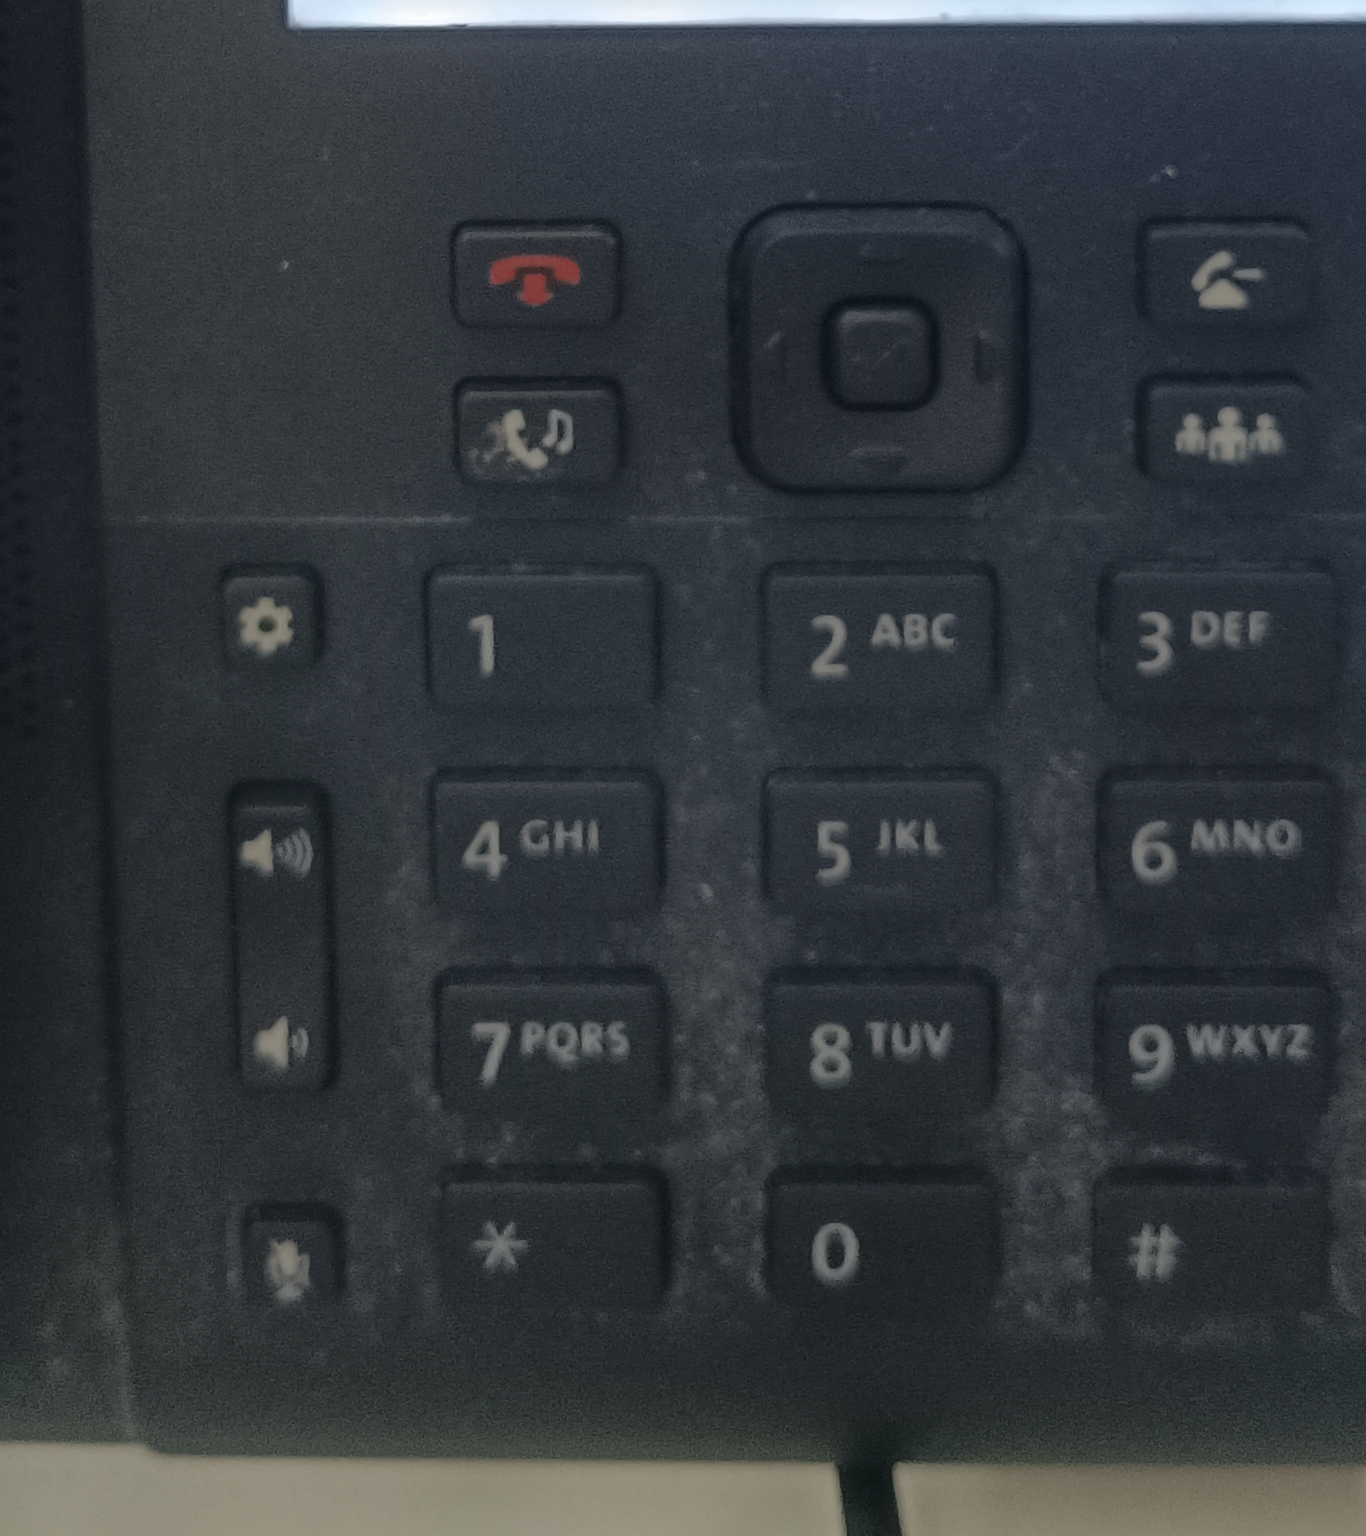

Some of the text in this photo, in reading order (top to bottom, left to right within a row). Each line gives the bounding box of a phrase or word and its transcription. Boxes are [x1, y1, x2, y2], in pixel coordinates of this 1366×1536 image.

[467, 613, 497, 678] 1
[811, 613, 957, 680] 2 ABC
[1137, 610, 1271, 676] 3 DEF
[461, 818, 600, 881] 4 GHI
[813, 818, 943, 886] 5 JKL
[1131, 818, 1303, 885] 6 MNO
[471, 1020, 631, 1087] 7 PQRS
[809, 1020, 952, 1089] 8 TUV
[1128, 1023, 1315, 1089] 9 WXYZ
[811, 1222, 860, 1287] 0
